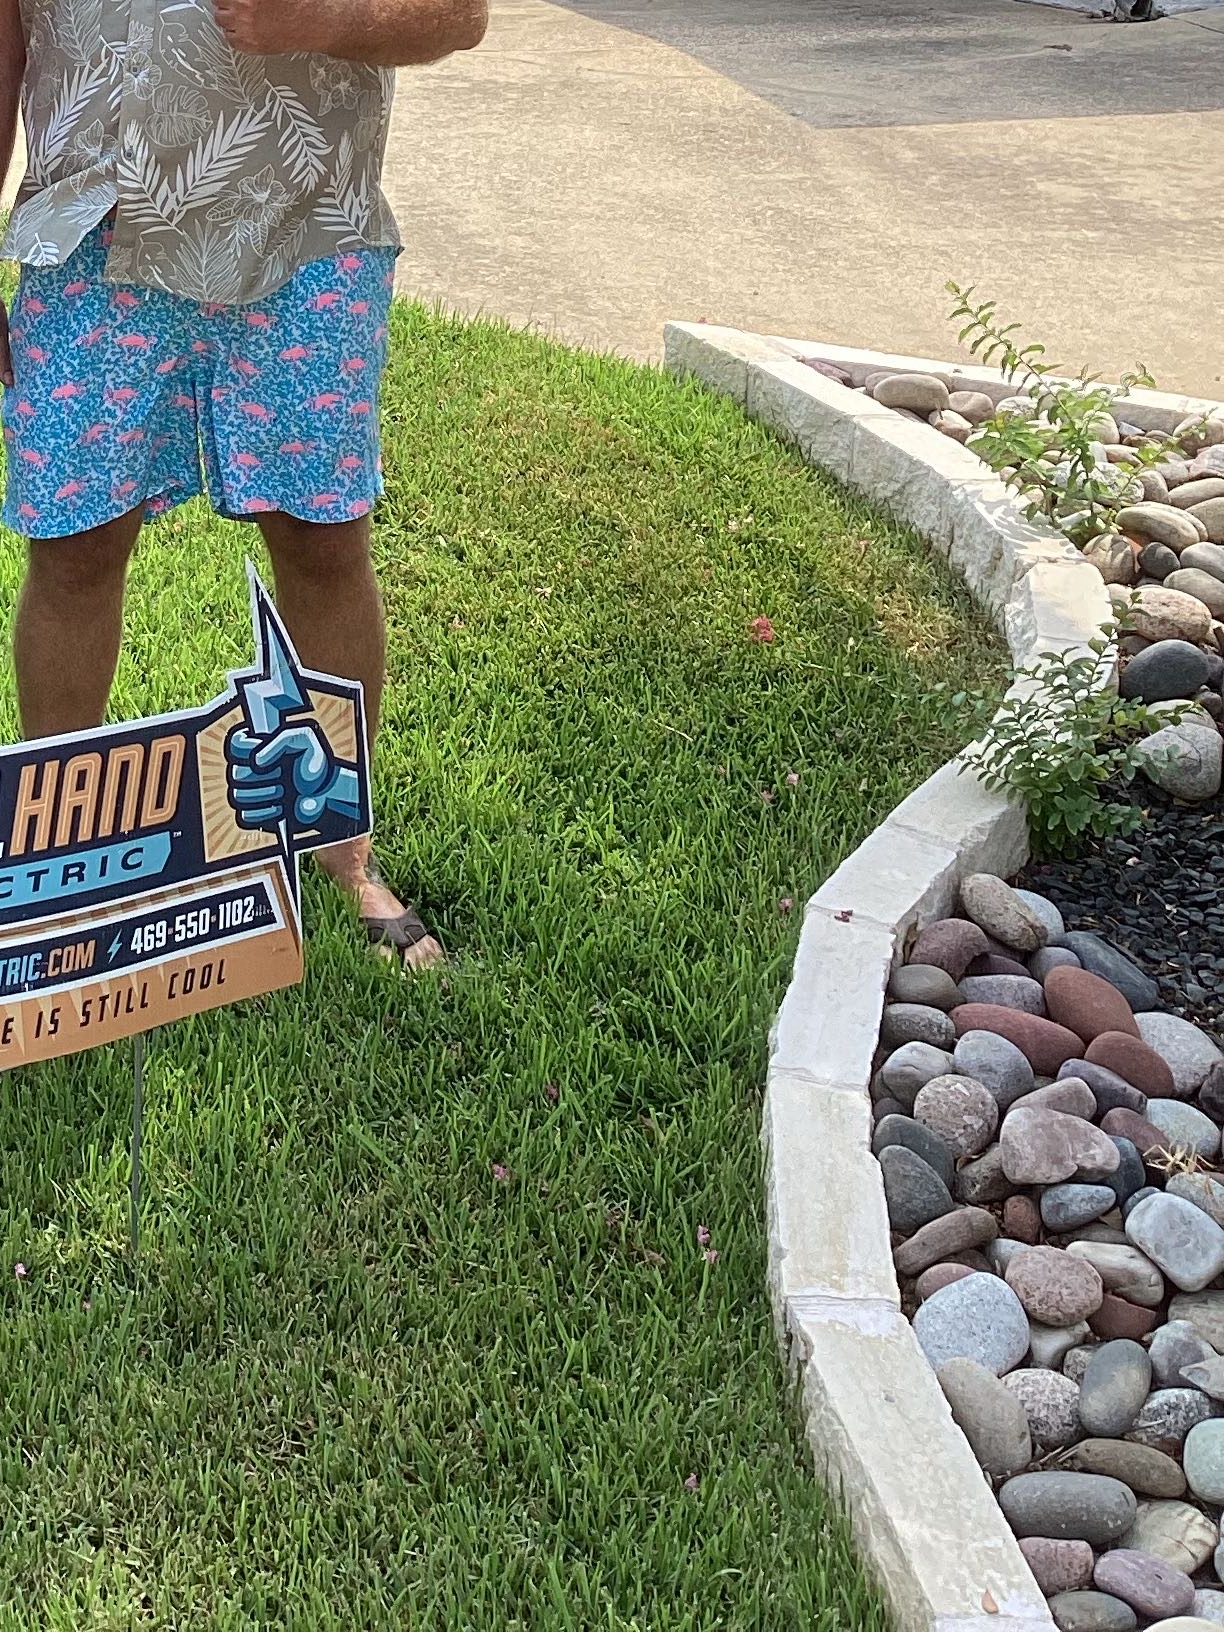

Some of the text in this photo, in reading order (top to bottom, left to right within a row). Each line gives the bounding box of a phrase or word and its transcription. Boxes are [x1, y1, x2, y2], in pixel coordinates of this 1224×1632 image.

[35, 1006, 61, 1039] IS
[79, 982, 149, 1028] STILL
[167, 958, 226, 1000] COOL
